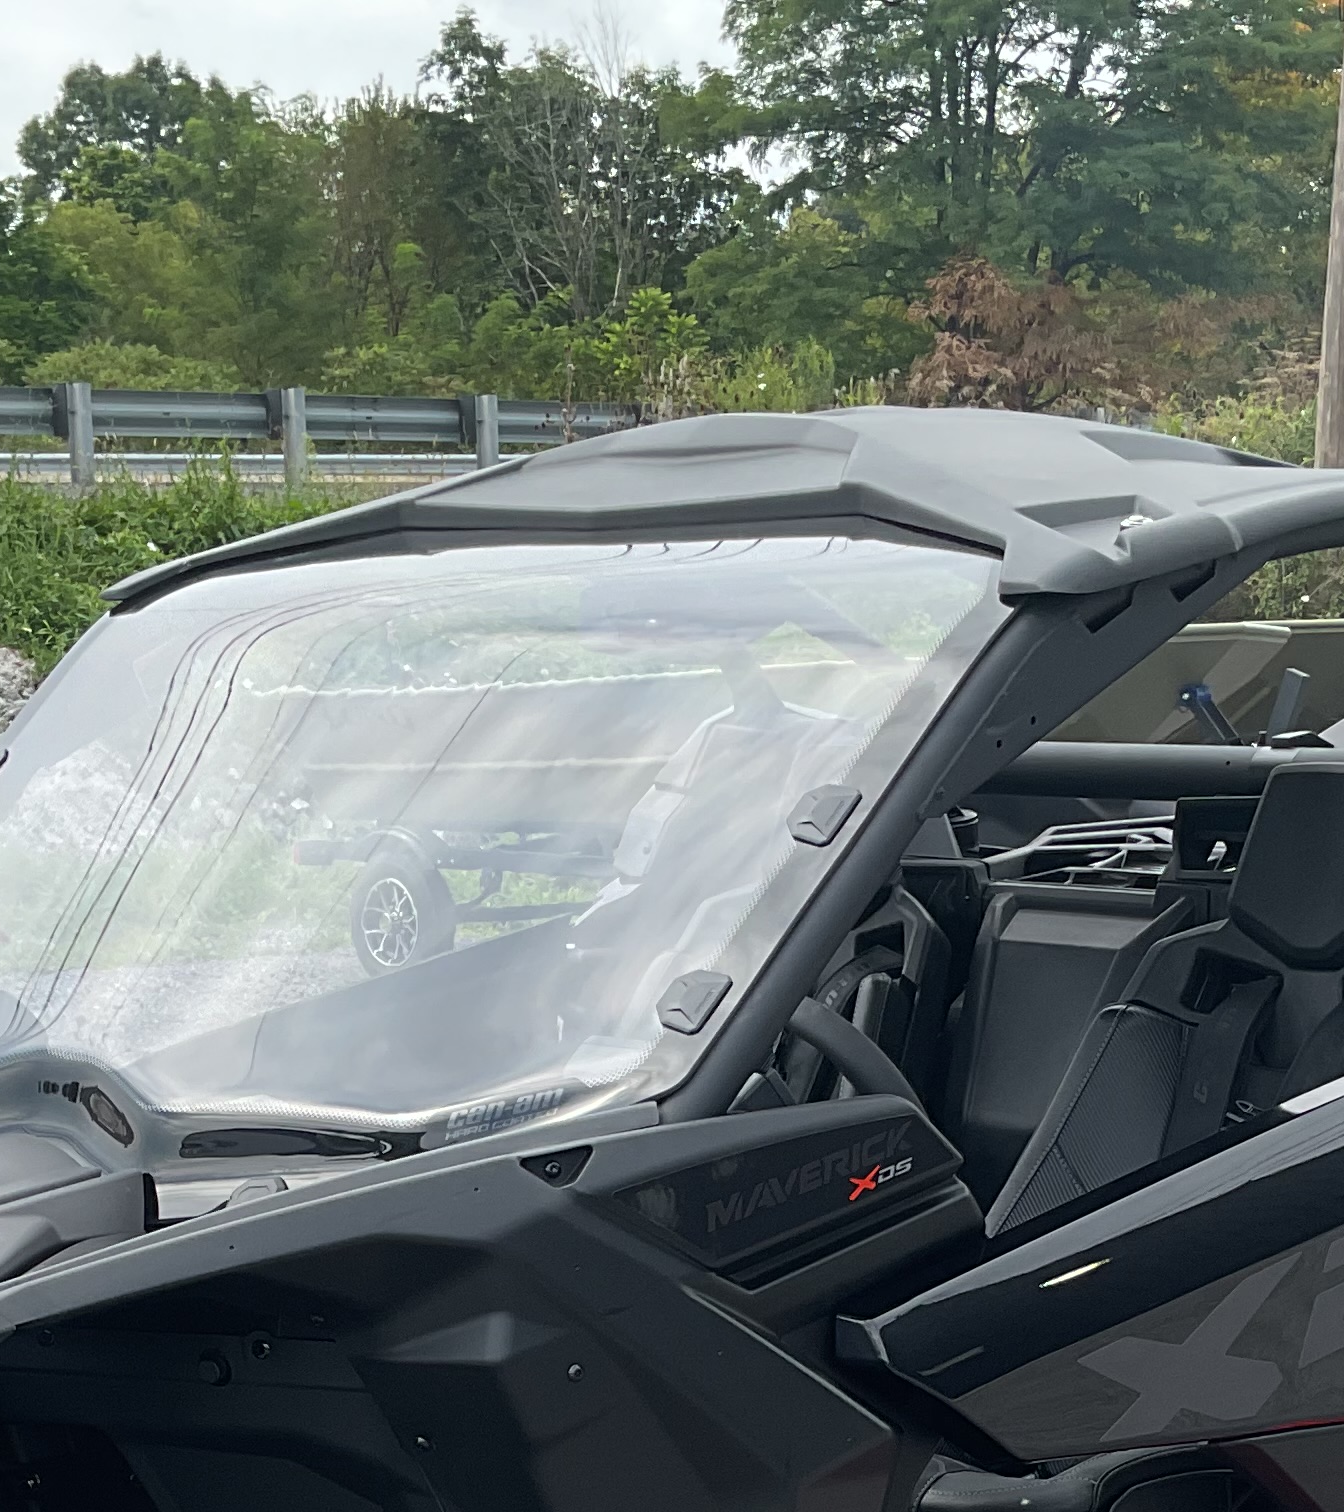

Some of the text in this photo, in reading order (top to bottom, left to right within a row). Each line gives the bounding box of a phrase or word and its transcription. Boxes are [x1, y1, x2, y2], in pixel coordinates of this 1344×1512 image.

[446, 1088, 564, 1130] can-am
[444, 1123, 489, 1141] HARD
[706, 1119, 913, 1233] MAVERICK
